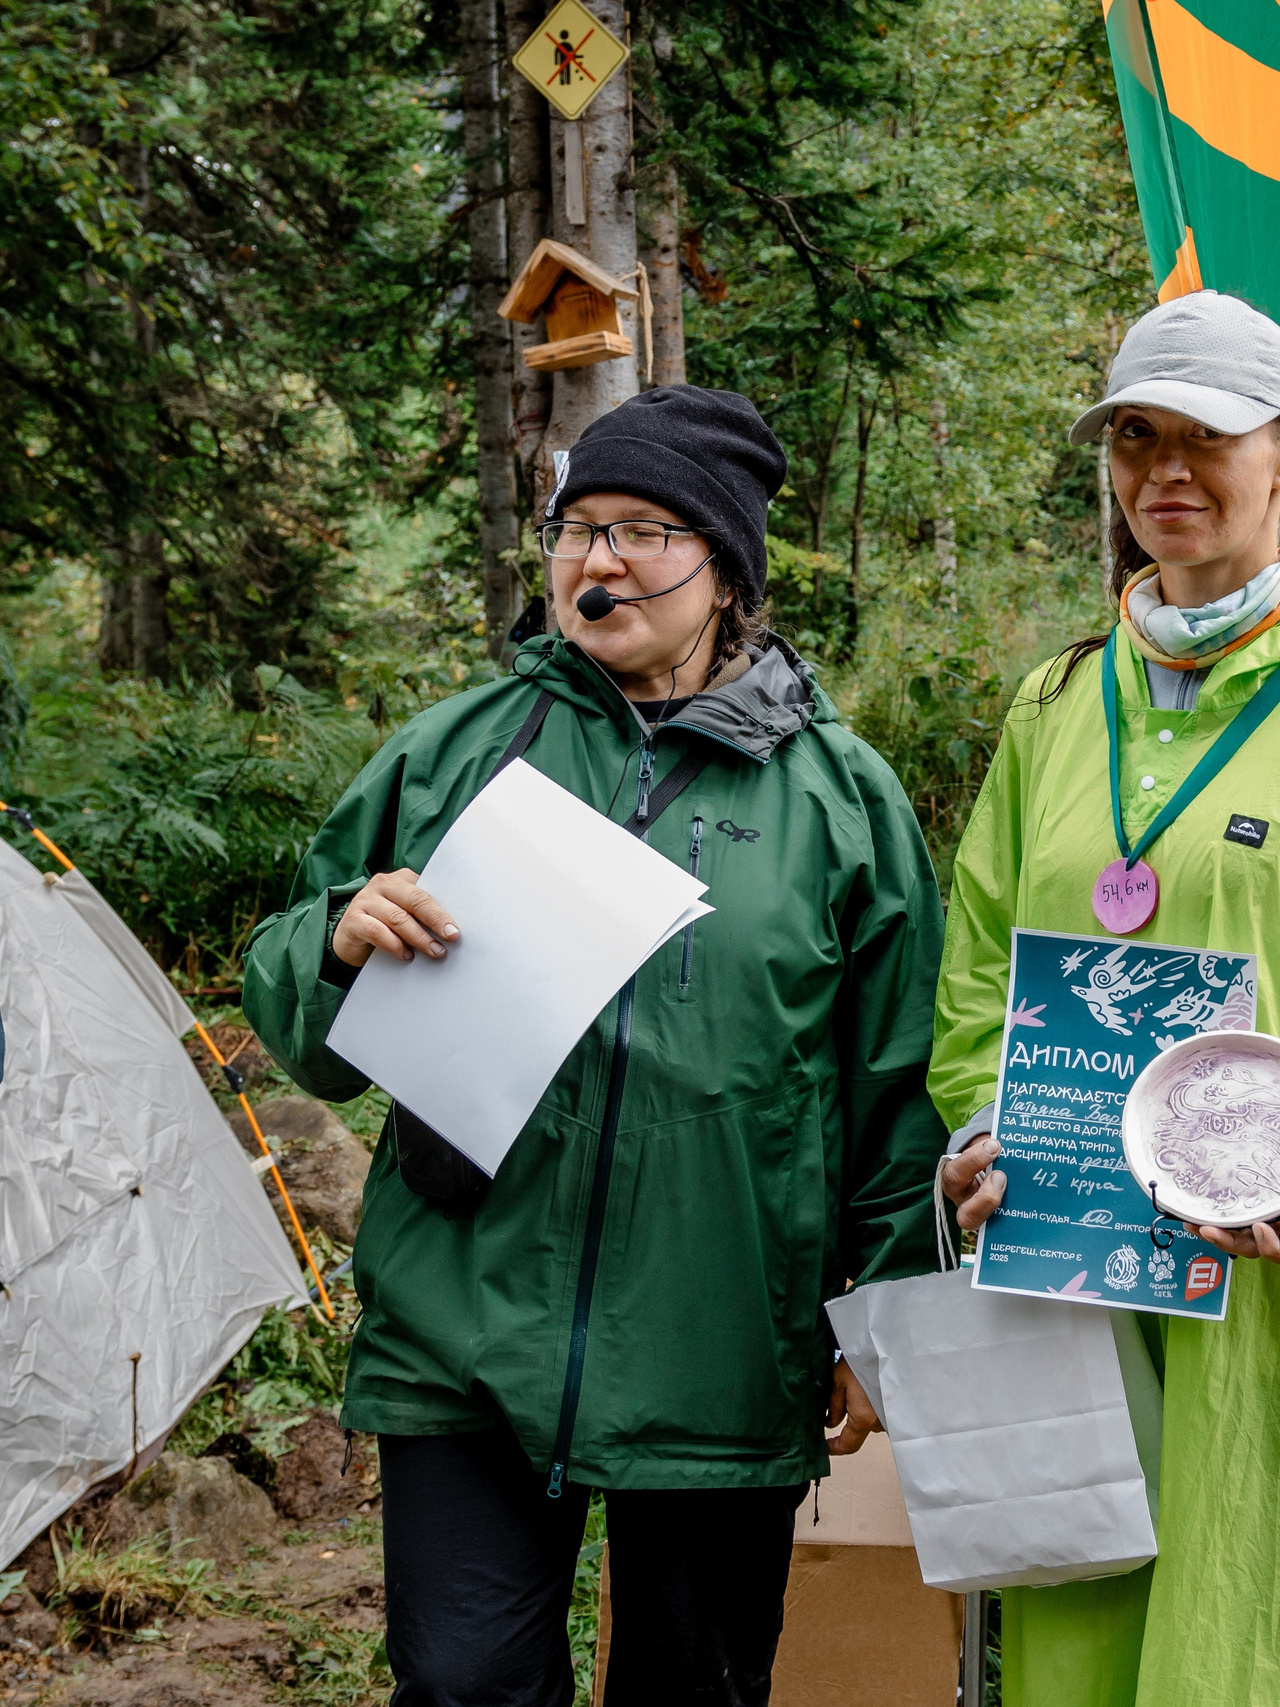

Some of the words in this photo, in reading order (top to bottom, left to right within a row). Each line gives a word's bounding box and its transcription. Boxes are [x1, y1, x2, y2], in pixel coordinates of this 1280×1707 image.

[1102, 878, 1134, 905] 54,6
[1009, 1041, 1135, 1080] ДИПЛОМ
[1007, 1081, 1128, 1106] НАГРАЖДАЕТС
[1003, 1115, 1017, 1126] ЗА
[1032, 1119, 1072, 1132] МЕСТО
[1073, 1124, 1081, 1134] В
[1039, 1136, 1078, 1152] РАУНД
[999, 1147, 1078, 1166] ДИСЦИПЛИНА
[1032, 1168, 1059, 1188] 42
[1070, 1177, 1124, 1196] круга
[994, 1207, 1038, 1220] ГЛАВНЫЙ
[1039, 1213, 1070, 1224] СУДЬЯ
[989, 1253, 1009, 1262] 2025
[1039, 1249, 1075, 1260] СЕКТОР
